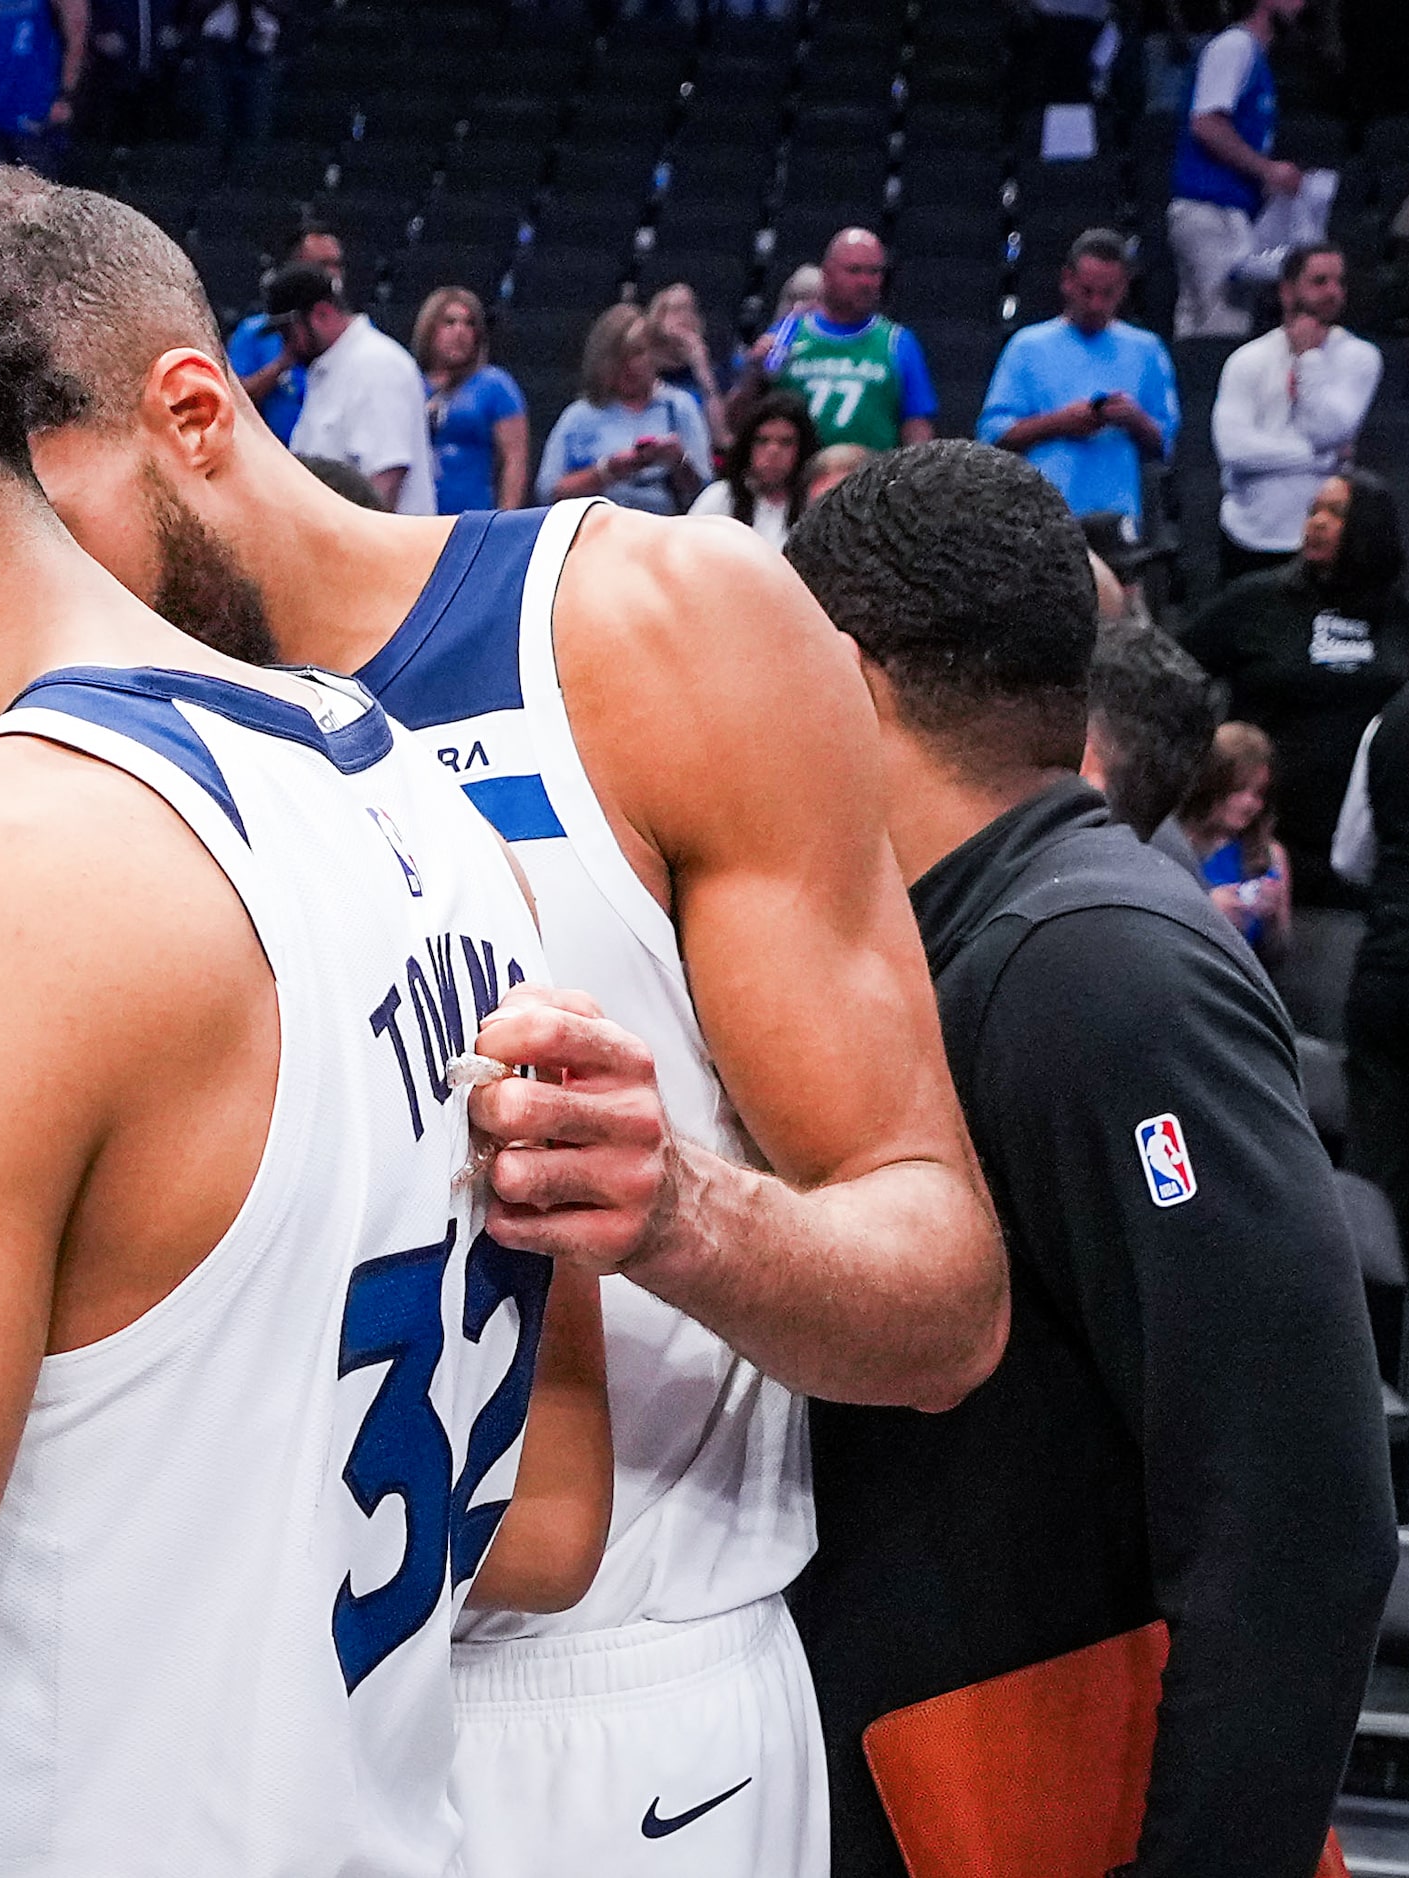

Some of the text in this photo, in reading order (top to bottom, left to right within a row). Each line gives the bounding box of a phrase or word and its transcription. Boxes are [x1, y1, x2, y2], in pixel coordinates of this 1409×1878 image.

[805, 379, 864, 429] 77
[437, 740, 490, 773] RA
[332, 1218, 554, 1698] 32
